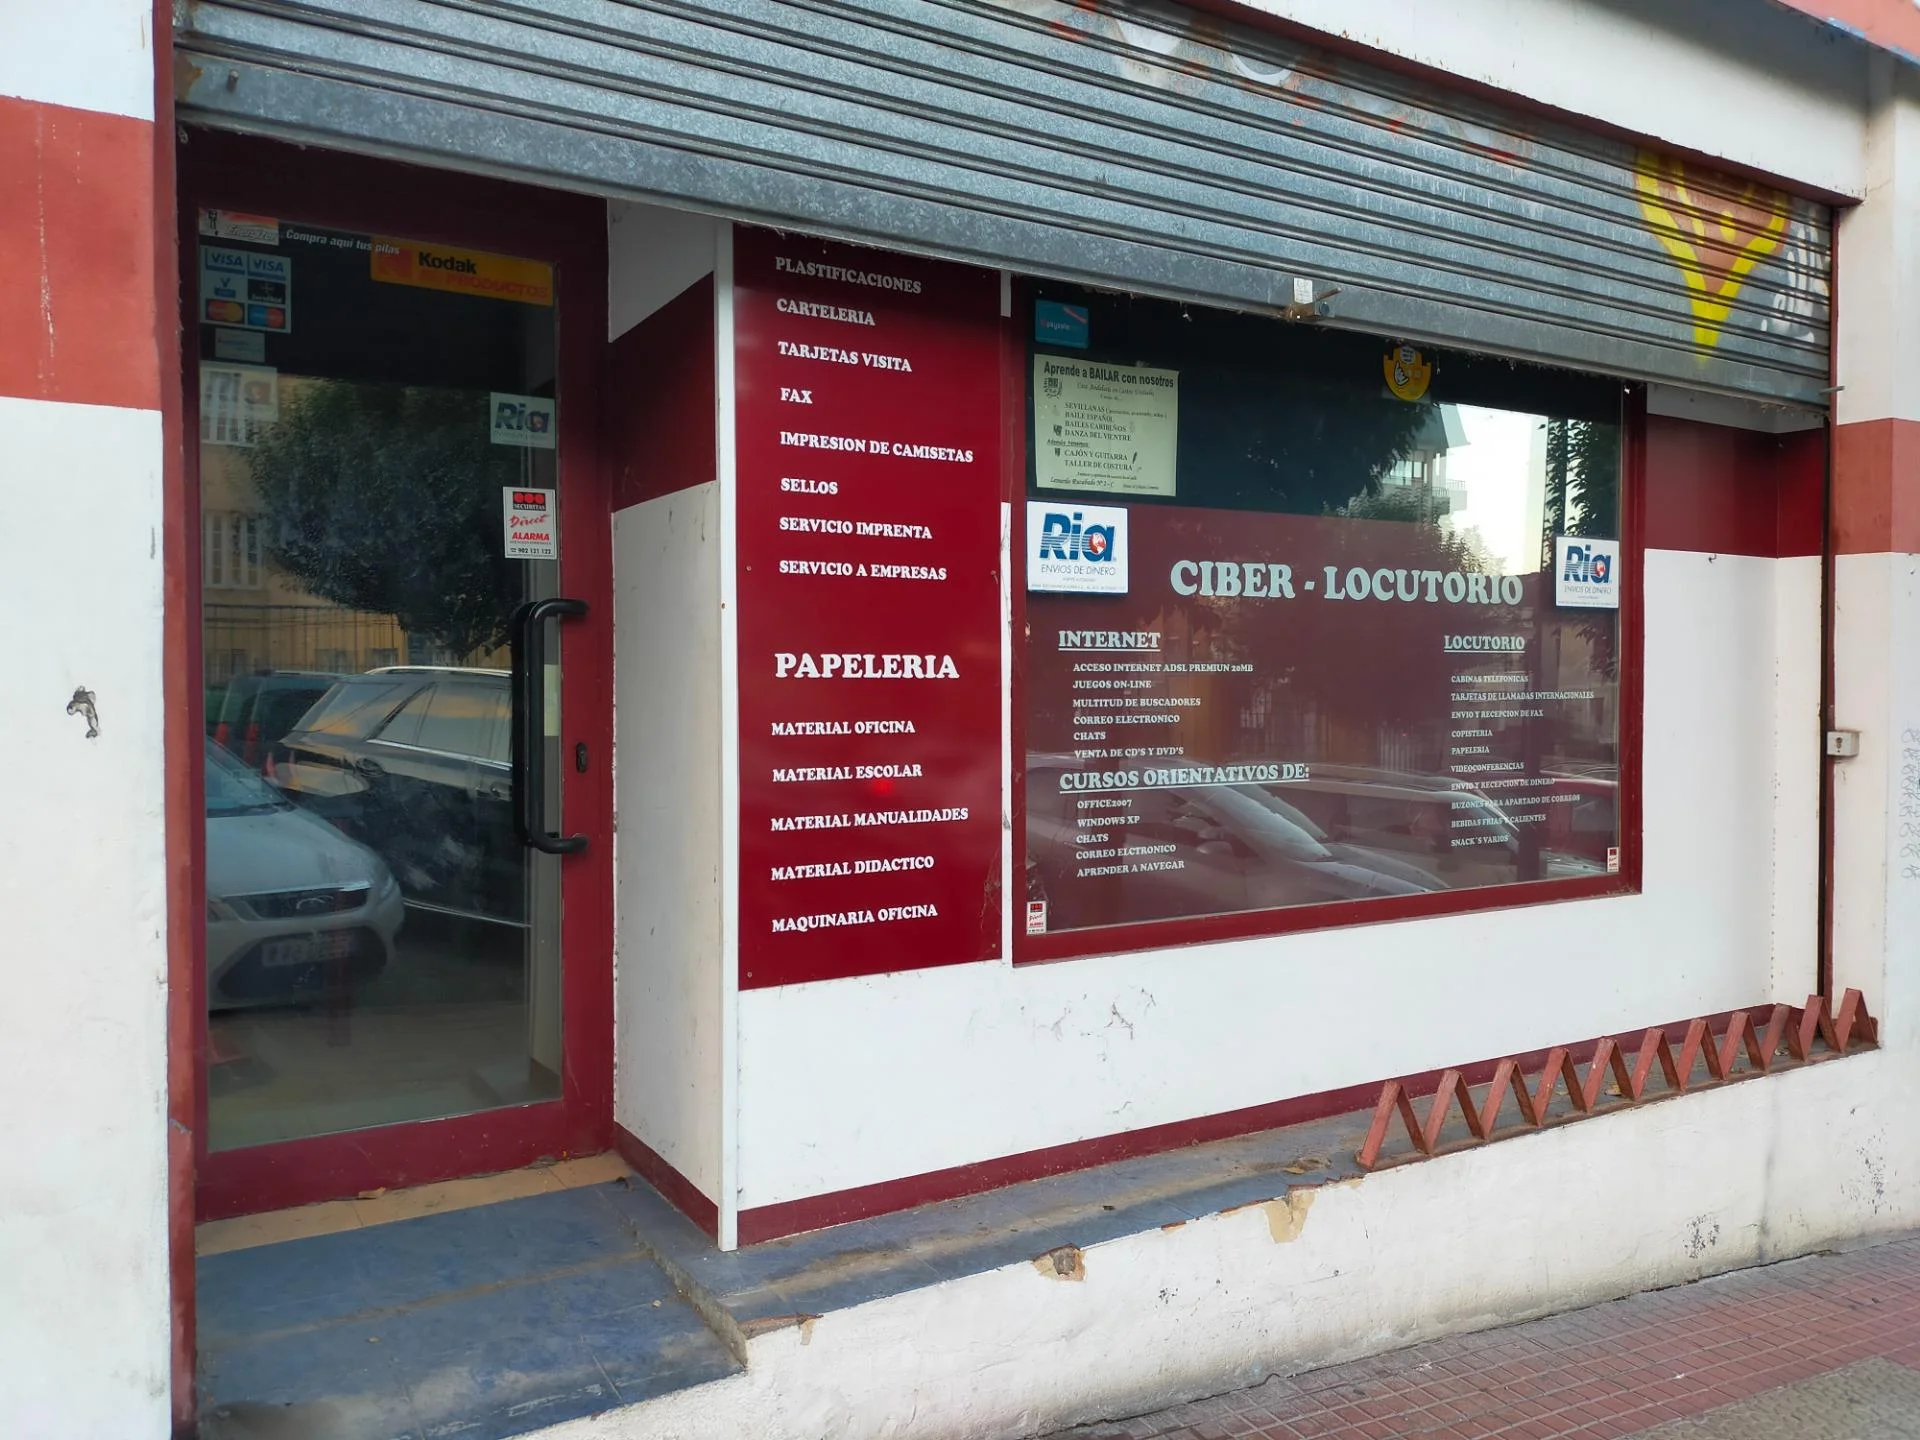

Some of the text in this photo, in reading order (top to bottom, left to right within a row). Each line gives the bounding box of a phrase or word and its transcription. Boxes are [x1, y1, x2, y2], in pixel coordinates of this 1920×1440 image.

[286, 229, 328, 245] Compra
[356, 239, 372, 251] tus
[375, 243, 400, 255] pilas
[211, 253, 243, 267] VISA
[254, 259, 284, 273] VISA
[418, 252, 477, 275] Kodak
[775, 256, 922, 294] PLASTIFICACIONES
[446, 271, 549, 299] PRODUCTOS
[776, 298, 876, 326] CARTELERIA
[777, 341, 912, 373] TARJETAS VISITA
[1044, 361, 1174, 388] Aprende a BAILAR con nosotros
[780, 387, 813, 404] FAX
[1064, 402, 1105, 413] SEVILLANAS
[495, 402, 550, 434] Ria
[1064, 429, 1131, 442] DANZA DEL VIENTRE
[780, 431, 974, 463] IMPRESION DE CAMISETAS
[1095, 451, 1128, 461] GUITARRA
[1064, 459, 1133, 472] TALLER DE COSTURA
[780, 477, 839, 495] SELLOS
[510, 514, 550, 528] Direct
[779, 517, 933, 539] SERVICIO IMPRENTA
[511, 532, 550, 541] ALARMA
[1039, 511, 1116, 563] Ria
[779, 560, 947, 581] SERVICIO A EMPRESAS
[1073, 565, 1085, 575] DE
[1086, 566, 1117, 576] DINERO
[1563, 544, 1612, 584] Ria
[1169, 559, 1296, 599] CIBER
[1323, 565, 1524, 606] LOCUTORIO
[1058, 630, 1161, 650] INTERNET
[1443, 634, 1526, 651] LOCUTORIO
[774, 652, 960, 679] PAPELERIA
[1073, 663, 1254, 673] ACCESO INTERNET ADSL PREMIUN 20MB
[1072, 680, 1152, 689] JUEGOS ON-LINE
[1451, 675, 1529, 683] CABINAS TELEFONICAS
[1072, 697, 1201, 708] MULTITUD DE BUSCADORES
[1450, 691, 1594, 701] TARJETAS DE LLAMADAS INTERNACIONALES
[1073, 714, 1180, 724] CORREO ELECTRONICO
[1451, 710, 1474, 719] ENVIO
[1474, 710, 1480, 718] Y
[1481, 710, 1519, 719] RECEPCION
[1530, 709, 1544, 717] FAX
[771, 720, 916, 736] MATERIAL OFICINA
[1073, 731, 1106, 741] CHATS
[1451, 729, 1493, 738] COPISTERIA
[1074, 746, 1184, 759] VENTA DE CD'S Y DVD'S
[1451, 746, 1490, 755] PAPELERIA
[772, 763, 923, 782] MATERIAL ESCOLAR
[1450, 761, 1525, 773] VIDEOCONFERENCIAS
[1059, 763, 1310, 790] CURSOS ORIENTATIVOS DE:
[1451, 777, 1556, 791] ENVIO Y RECEPCION DE DINERO
[1077, 798, 1133, 809] OFFICE2007
[1451, 799, 1485, 809] BUZONES
[1505, 796, 1541, 806] APARTADO
[1542, 795, 1551, 804] DE
[1551, 793, 1581, 803] CORREOS
[770, 807, 969, 832] MATERIAL MANUALIDADES
[1077, 815, 1140, 828] WINDOWS XP
[1451, 818, 1482, 828] BEBIDAS
[1482, 816, 1503, 826] FRIAS
[1510, 813, 1547, 823] CALIENTES
[1076, 833, 1109, 844] CHATS
[1483, 834, 1509, 844] VARIOS
[1075, 844, 1177, 860] CORREO ELCTRONICO
[770, 855, 935, 881] MATERIAL DIDACTICO
[1076, 860, 1185, 878] APRENDER A NAVEGAR
[772, 903, 939, 933] MAQUINARIA OFICINA
